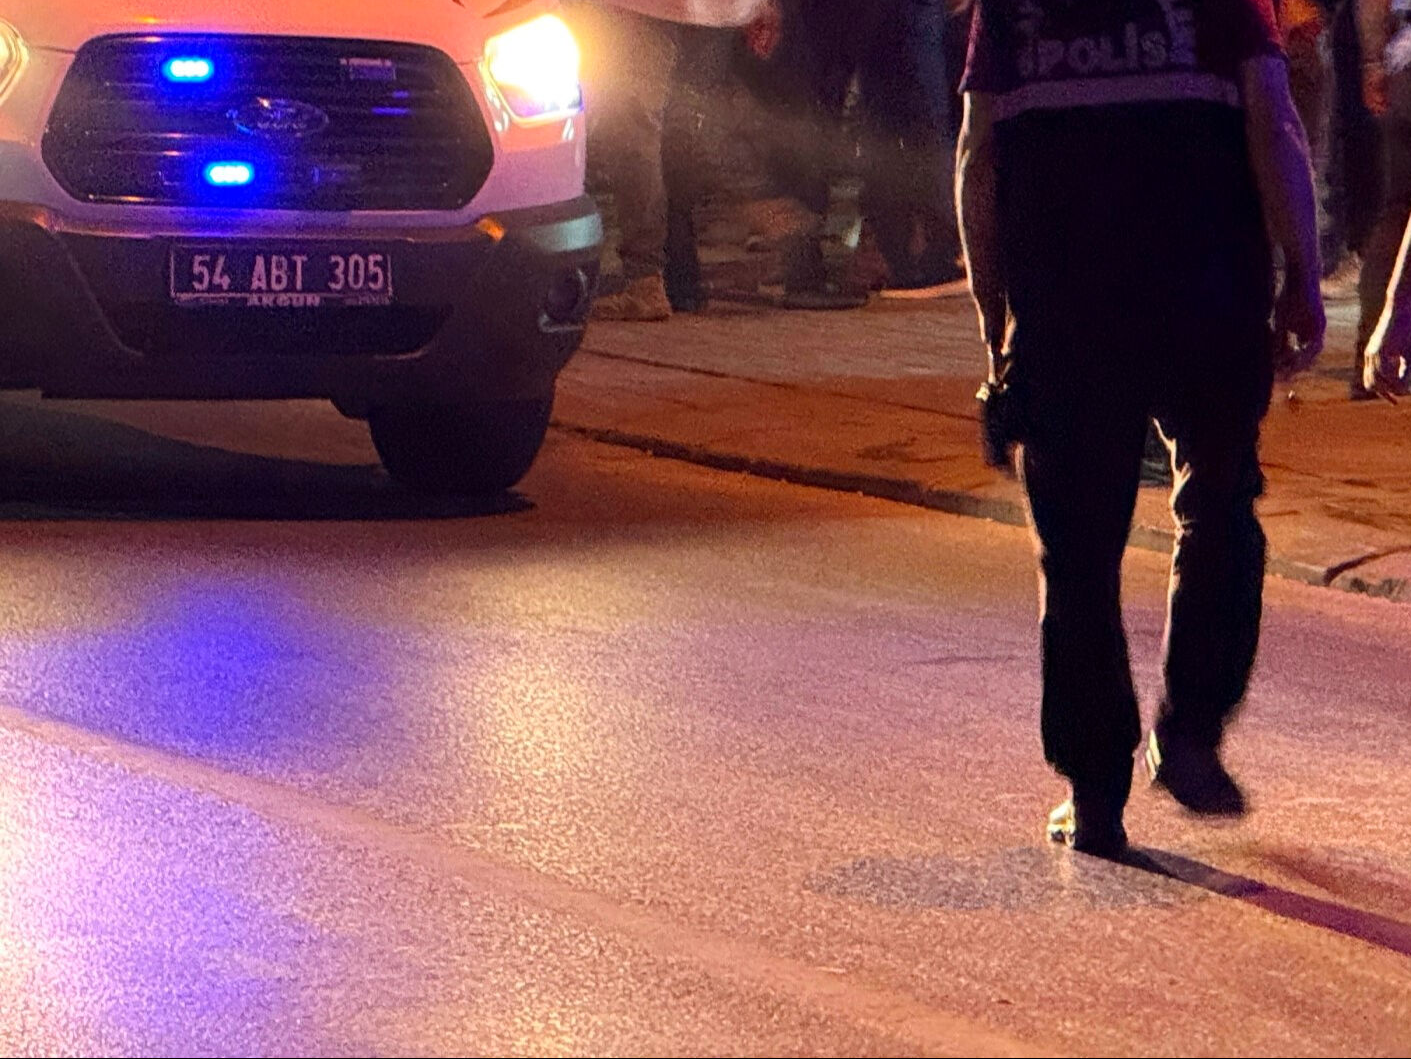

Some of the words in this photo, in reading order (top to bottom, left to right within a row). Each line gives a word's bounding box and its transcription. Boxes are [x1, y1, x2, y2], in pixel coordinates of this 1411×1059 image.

[191, 253, 232, 292] 54
[250, 253, 308, 292] ABT
[327, 252, 385, 292] 305
